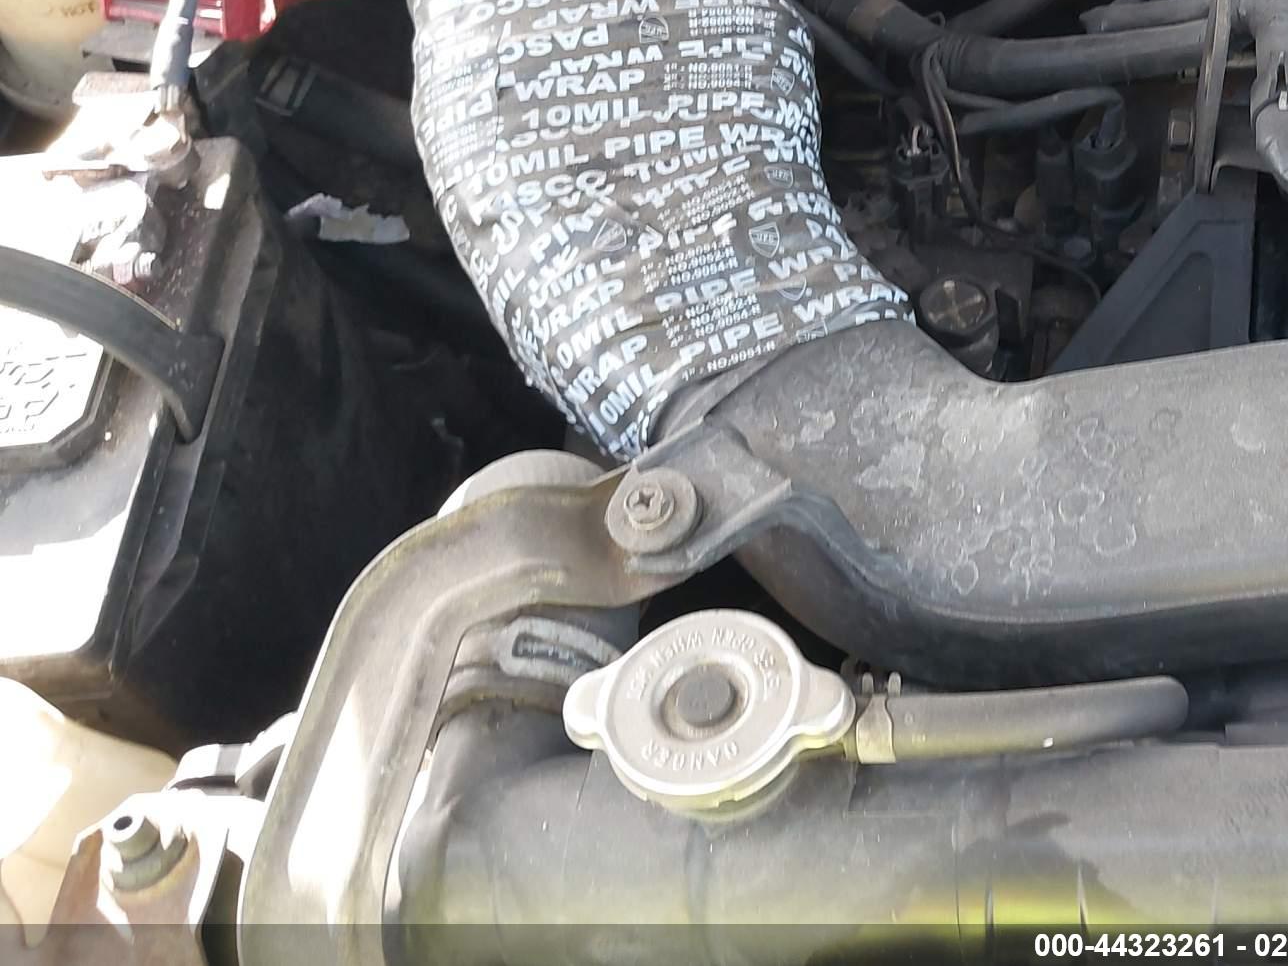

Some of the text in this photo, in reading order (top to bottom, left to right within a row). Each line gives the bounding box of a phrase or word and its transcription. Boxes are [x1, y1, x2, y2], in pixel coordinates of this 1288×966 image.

[514, 67, 646, 103] WRAP
[521, 96, 652, 129] 10MIL
[603, 124, 707, 160] PIPE
[653, 267, 759, 314] PIPE
[564, 311, 785, 406] WRAP PIPE
